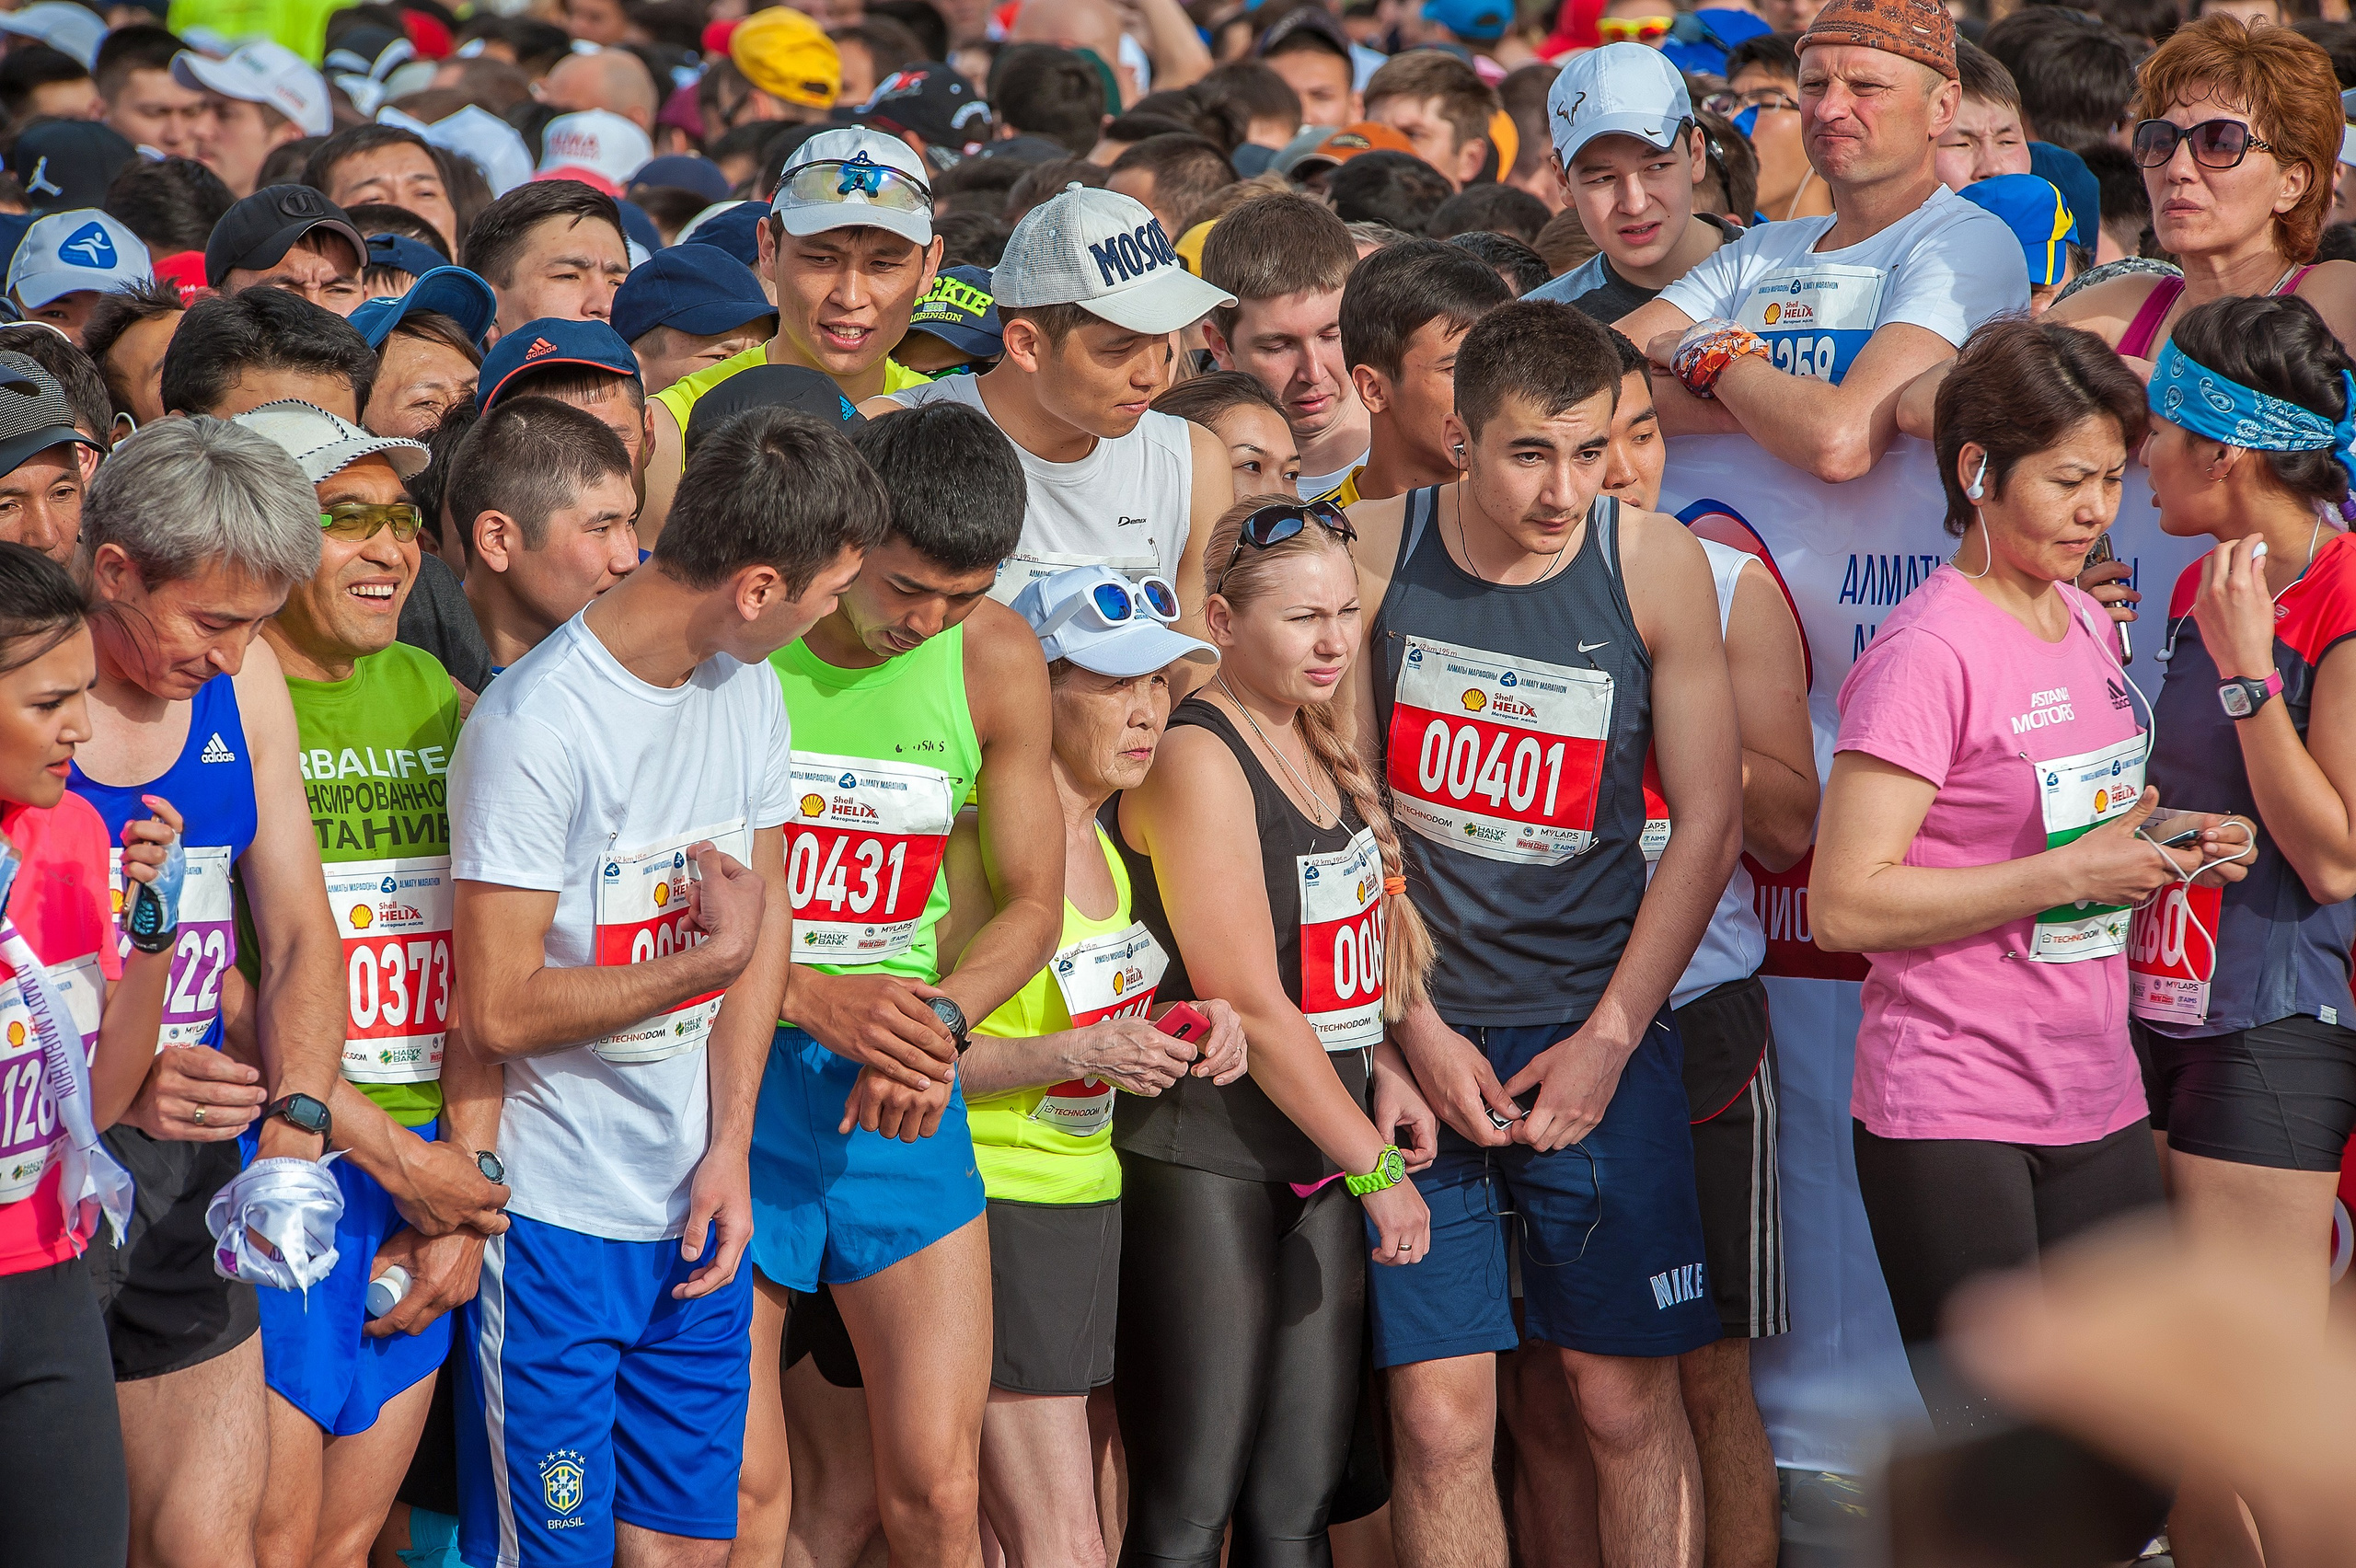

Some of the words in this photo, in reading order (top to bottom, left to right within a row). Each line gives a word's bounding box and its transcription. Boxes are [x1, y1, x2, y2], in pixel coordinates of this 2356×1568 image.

[1784, 305, 1813, 318] HELIX
[525, 344, 558, 360] adidas
[1839, 554, 1942, 605] АЛМАТ
[1447, 663, 1467, 674] АЛМАТЫ
[1468, 667, 1497, 680] МАРАФОНЫ
[1519, 677, 1539, 689] ALMATY
[1540, 681, 1567, 694] MARATHON
[1495, 693, 1514, 702] Shell
[1493, 701, 1538, 718] HELIX
[2011, 703, 2074, 734] MOTORS
[201, 752, 236, 764] adidas
[1418, 719, 1565, 817] 00401
[804, 772, 837, 783] МАРАФОНЫ
[860, 778, 880, 789] ALMATY
[880, 781, 908, 791] MARATHON
[305, 778, 447, 814] НСИРОВАННО
[833, 796, 854, 804] Shell
[2111, 786, 2137, 803] HELIX
[832, 802, 879, 819] HELIX
[1403, 803, 1452, 828] TECHNODOM
[1477, 832, 1503, 842] BANK
[1478, 826, 1507, 836] HALYK
[1541, 828, 1579, 839] MYLAPS
[1518, 839, 1534, 848] World
[1533, 842, 1550, 851] Class
[673, 875, 685, 884] Shell
[783, 831, 907, 915] 0431
[350, 882, 377, 892] МАРАФОНЫ
[379, 901, 397, 909] Shell
[379, 905, 422, 921] HELIX
[881, 922, 913, 933] MYLAPS
[2052, 928, 2099, 943] TECHNODOM
[1126, 969, 1143, 986] HELIX
[2166, 980, 2199, 991] MYLAPS
[1319, 1017, 1371, 1032] TECHNODOM
[14, 964, 50, 1017] ALMATY
[35, 1018, 77, 1100] MARATHON
[611, 1029, 665, 1043] TECHNODOM
[1055, 1107, 1100, 1117] TECHNODOM
[1650, 1263, 1703, 1310] NIKE
[548, 1516, 585, 1529] BRASIL
